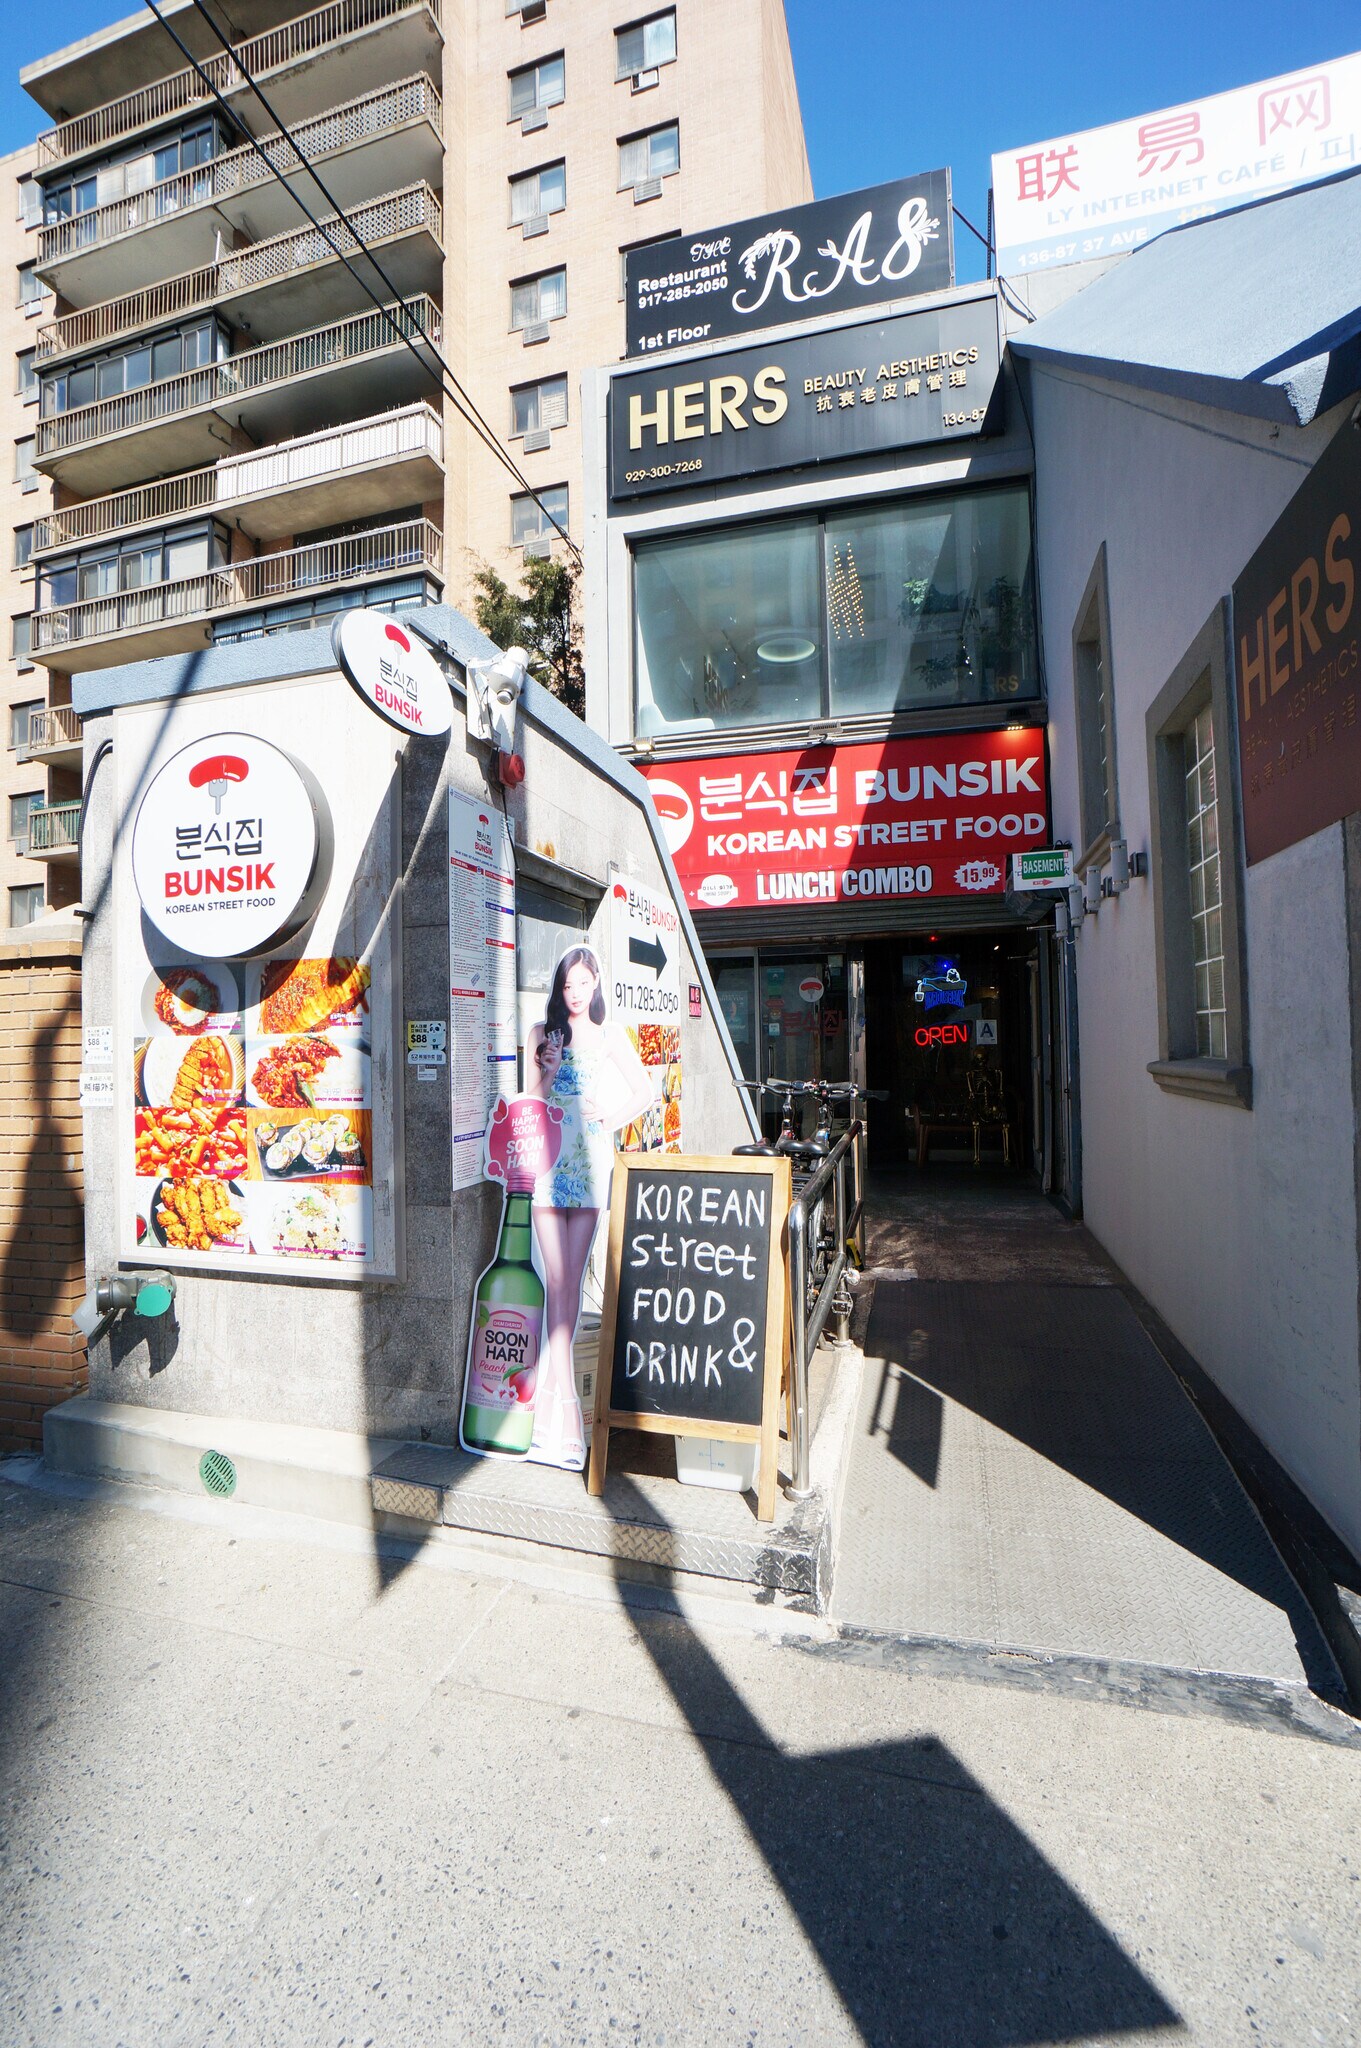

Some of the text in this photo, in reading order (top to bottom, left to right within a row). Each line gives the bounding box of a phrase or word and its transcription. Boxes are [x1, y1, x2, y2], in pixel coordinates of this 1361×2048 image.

[1048, 207, 1072, 226] LY
[1083, 175, 1209, 218] INTERNET
[1217, 153, 1287, 186] CAFÉ
[1018, 227, 1148, 267] 136-87 37 AVE
[638, 260, 727, 293] Restaurant
[638, 276, 728, 309] 917-285-2050
[638, 323, 711, 350] 1st Floor
[804, 346, 979, 395] BEAUTY AESTHETICS
[816, 369, 967, 413] 抗衰老皮膚管理
[629, 366, 789, 451] HERS
[625, 459, 703, 483] 929-300-7268
[1240, 512, 1354, 722] HERS
[379, 656, 418, 702] 분식집
[1287, 640, 1358, 721] AESTHETICS
[375, 683, 423, 727] BUNSIK
[699, 766, 838, 822] 분식집
[855, 756, 1042, 805] BUNSIK
[176, 818, 262, 861] 분식집
[475, 841, 494, 856] BUNSIK
[708, 812, 1046, 857] KOREAN STREET FOOD
[165, 862, 276, 898] BUNSIK
[756, 864, 933, 901] LUNCH COMBO
[962, 867, 996, 885] 15.99
[1022, 858, 1064, 874] BASEMENT
[166, 897, 276, 915] KOREAN STREET FOOD
[628, 888, 651, 926] 분식집
[652, 905, 678, 933] BUNSIK
[615, 982, 679, 1014] 917.285.2050
[88, 1038, 100, 1046] $88
[411, 1034, 427, 1043] $88
[914, 1023, 969, 1047] OPEN
[980, 1023, 994, 1038] A
[511, 1114, 541, 1127] HAPPY
[521, 1106, 533, 1116] BE
[506, 1135, 544, 1154] SOON
[513, 1124, 537, 1136] SOON
[507, 1152, 540, 1169] HARI
[636, 1182, 765, 1227] KOREAN
[629, 1232, 757, 1280] Street
[632, 1287, 726, 1325] FOOD
[485, 1329, 529, 1348] SOON
[486, 1345, 525, 1363] HARI
[625, 1317, 757, 1387] DRINK &
[479, 1360, 507, 1373] Peach
